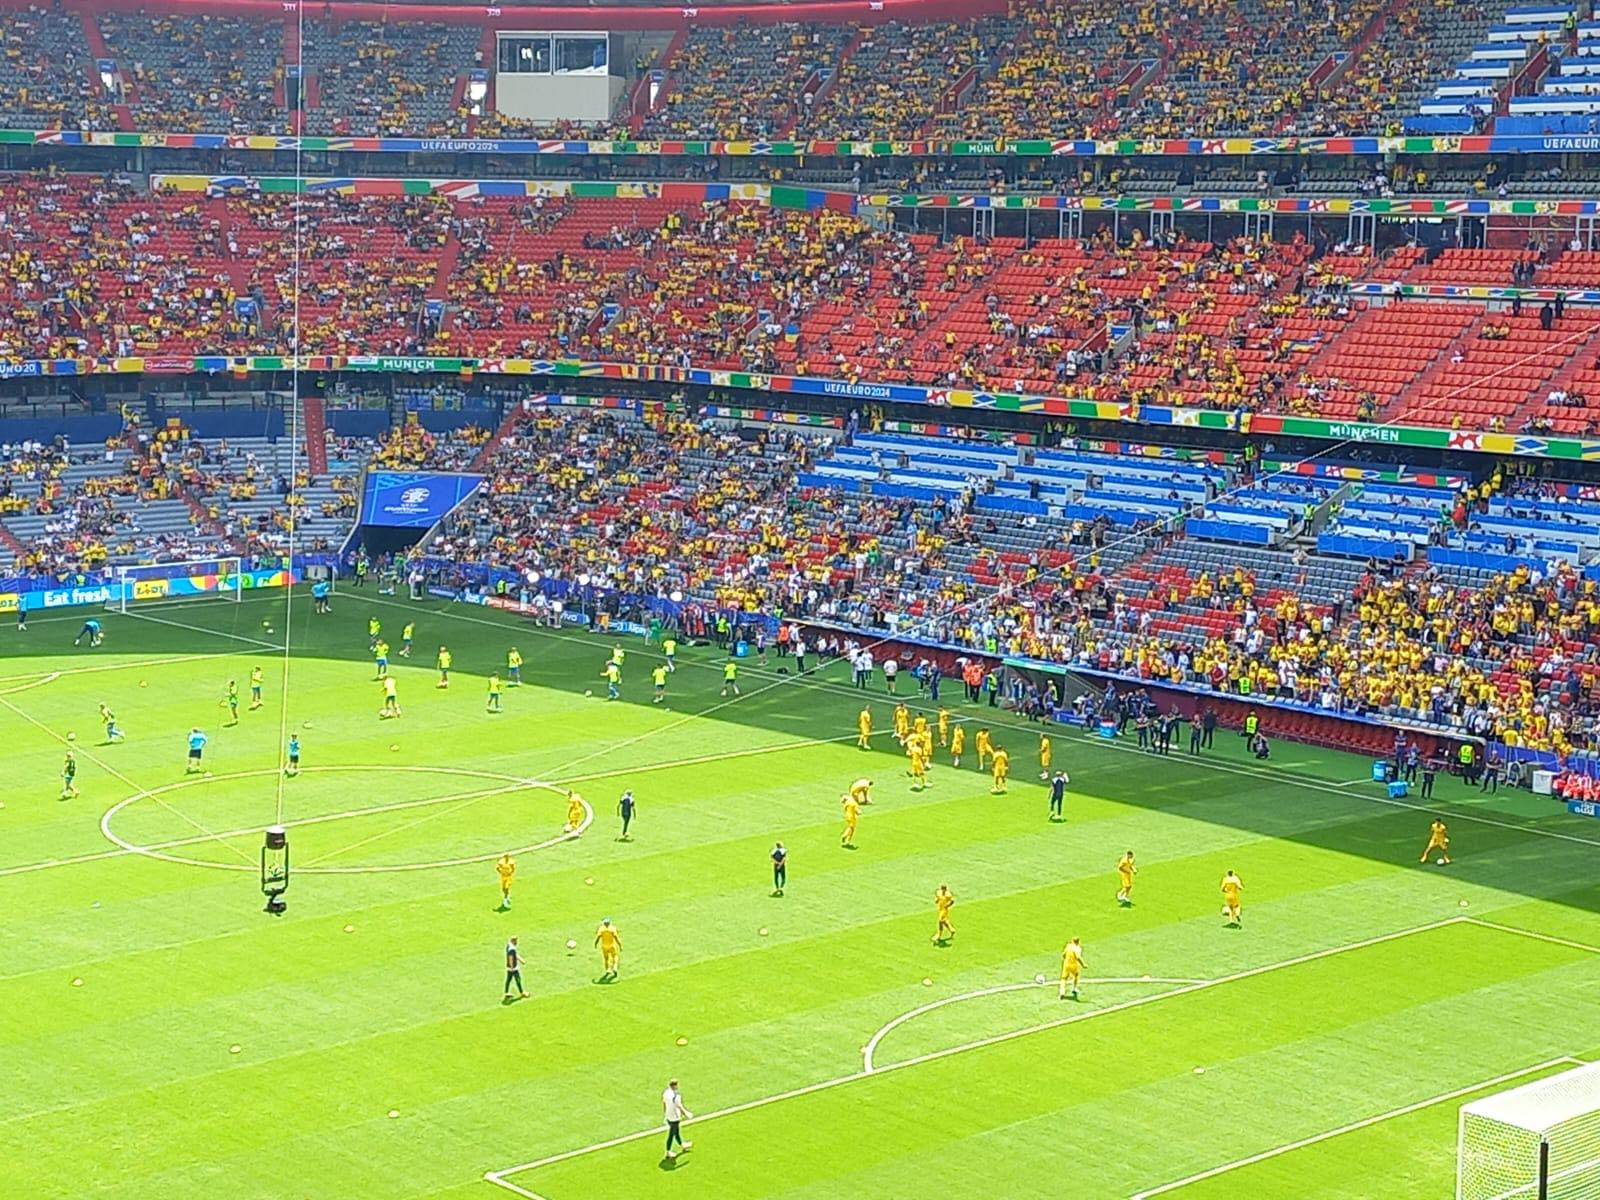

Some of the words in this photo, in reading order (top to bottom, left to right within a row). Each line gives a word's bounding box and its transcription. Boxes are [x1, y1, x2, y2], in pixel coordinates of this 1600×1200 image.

[384, 359, 435, 369] MUNICH
[44, 591, 68, 606] Eat
[72, 586, 111, 604] fresh
